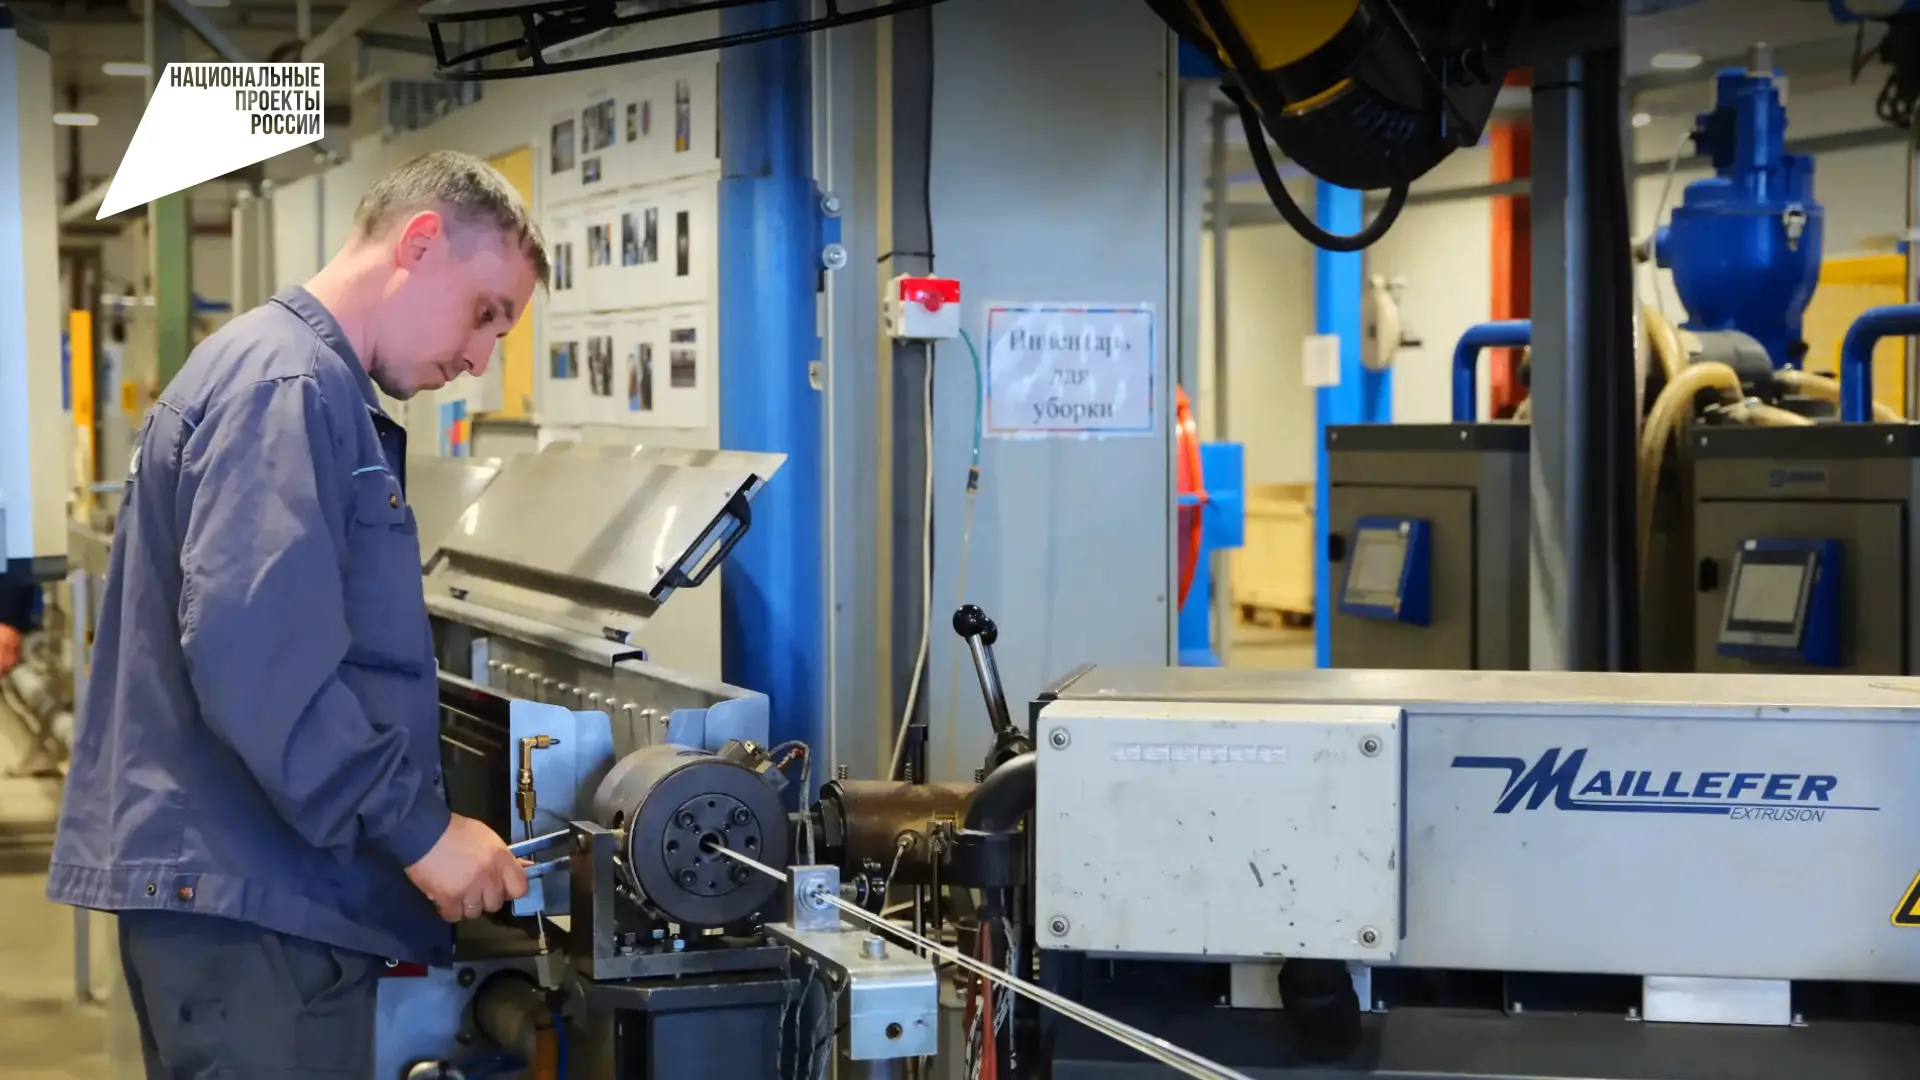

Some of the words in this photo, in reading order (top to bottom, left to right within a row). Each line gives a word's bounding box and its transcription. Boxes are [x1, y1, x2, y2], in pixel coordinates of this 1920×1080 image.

[1032, 396, 1113, 424] уборки
[1451, 747, 1837, 813] MAILLEFER
[1729, 807, 1825, 822] EXTRUSION
